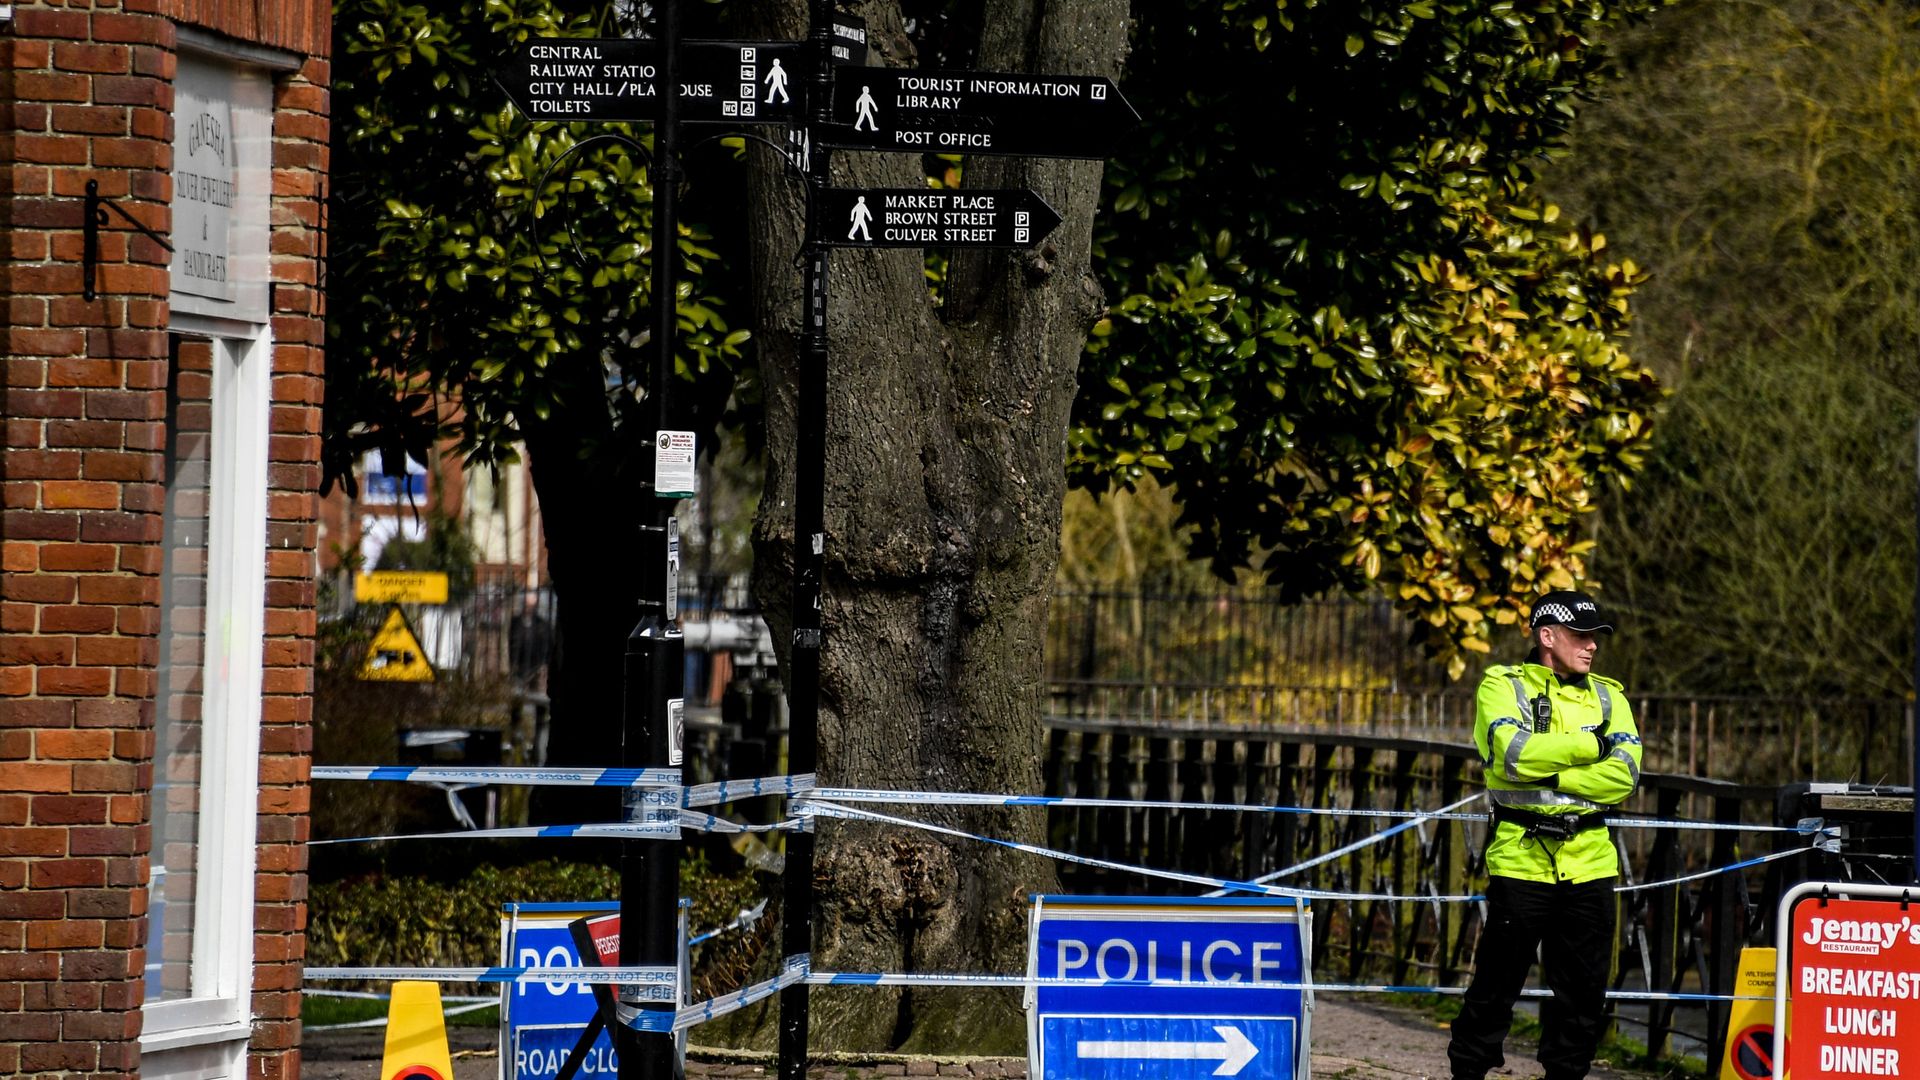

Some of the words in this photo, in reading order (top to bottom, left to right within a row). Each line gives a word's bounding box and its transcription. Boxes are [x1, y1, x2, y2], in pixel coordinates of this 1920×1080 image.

[530, 46, 602, 59] CENTRAL
[530, 64, 595, 77] RAILWAY
[603, 65, 656, 78] STATIO
[529, 82, 565, 95] CITY
[898, 77, 964, 92] TOURIST
[970, 80, 1081, 97] INFORMATION
[530, 101, 591, 113] TOILETS
[896, 95, 962, 110] LIBRARY
[189, 113, 225, 166] GANESHA
[895, 131, 933, 145] POST
[939, 132, 992, 147] OFFICE
[177, 170, 198, 200] SILVER
[885, 195, 947, 209] MARKET
[953, 196, 995, 209] PLACE
[885, 212, 938, 225] BROWN
[943, 212, 997, 225] STREET
[884, 229, 938, 242] CULVER
[943, 229, 997, 242] STREET
[1803, 917, 1920, 948] Jenny's
[1823, 943, 1878, 953] RESTAURANT
[1057, 938, 1283, 983] POLICE
[1802, 967, 1920, 1000] BREAKFAST
[1825, 1007, 1897, 1037] LUNCH
[1820, 1045, 1900, 1076] DINNER
